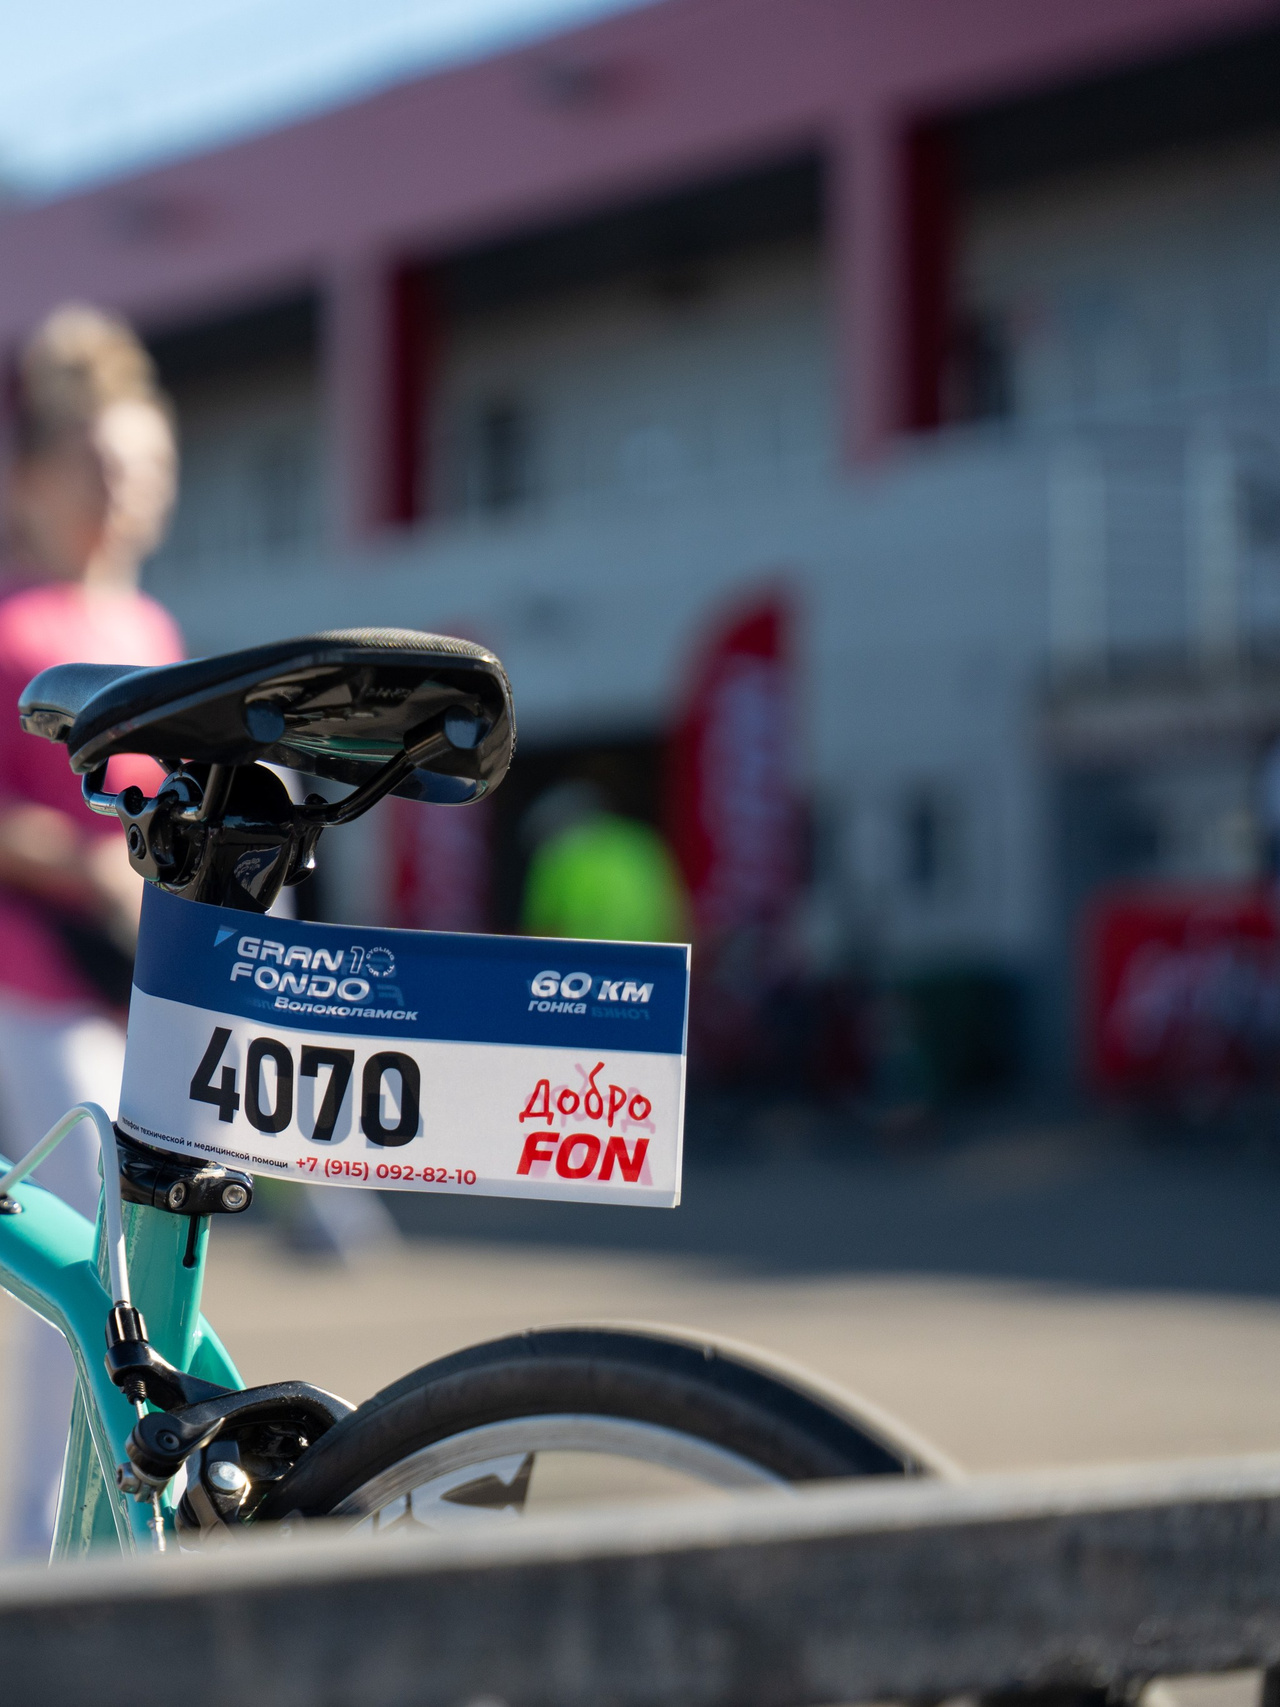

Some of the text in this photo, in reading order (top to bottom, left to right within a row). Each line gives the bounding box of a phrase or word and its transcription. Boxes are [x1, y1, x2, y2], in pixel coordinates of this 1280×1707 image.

[237, 936, 345, 972] GRAN
[365, 946, 396, 962] CYCLING
[365, 963, 396, 977] FOR ALL
[230, 962, 371, 1002] FONDO
[531, 969, 593, 999] 60
[274, 996, 419, 1021] Волоколамск
[528, 1000, 587, 1015] гонка
[189, 1026, 421, 1148] 4070
[519, 1061, 652, 1128] Добро
[140, 1126, 185, 1146] технической
[186, 1140, 193, 1148] и
[194, 1142, 250, 1161] медицинской
[252, 1156, 289, 1169] помощи
[296, 1156, 318, 1172] +7
[324, 1158, 370, 1181] (915)
[376, 1163, 477, 1186] 092-82-10
[516, 1131, 650, 1183] FON
